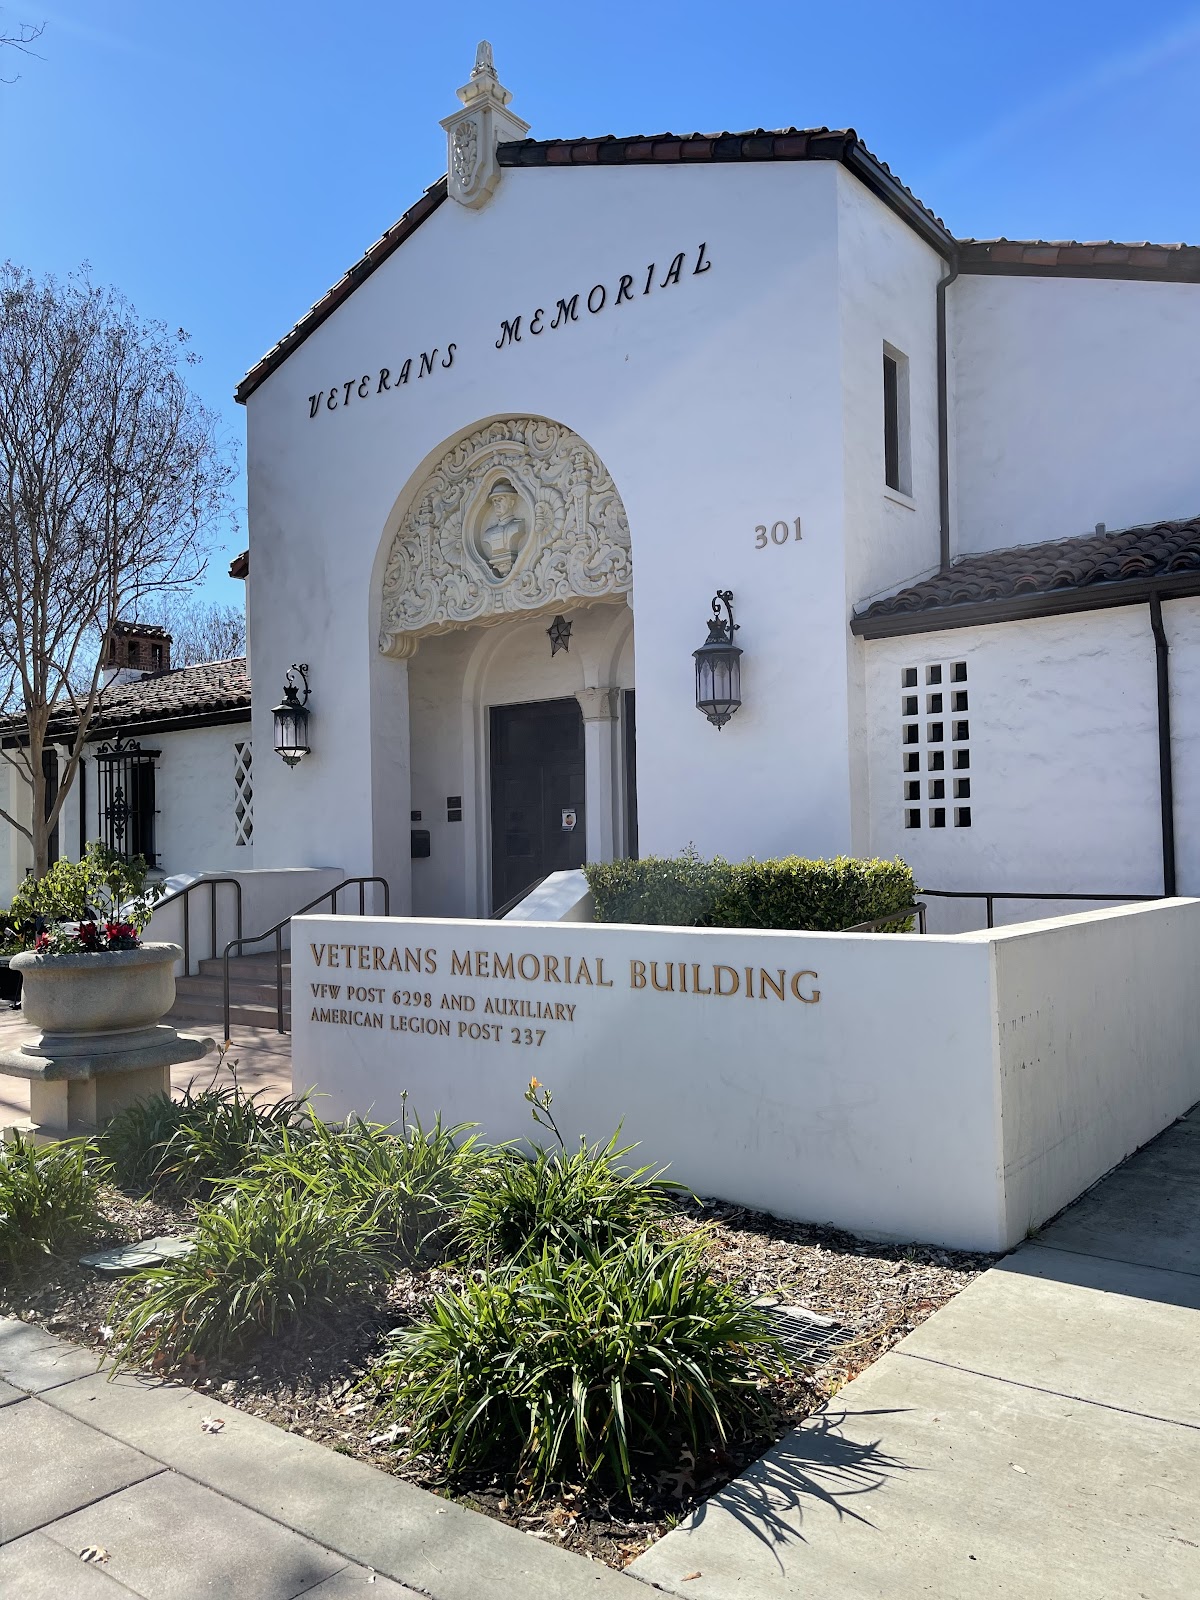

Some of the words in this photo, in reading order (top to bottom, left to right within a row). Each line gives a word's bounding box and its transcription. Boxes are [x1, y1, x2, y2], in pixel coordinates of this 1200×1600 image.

[308, 343, 457, 418] VETERANS
[495, 242, 712, 349] MEMORIAL
[755, 517, 802, 549] 301
[310, 943, 437, 974] VETERANS
[450, 950, 613, 987] MEMORIAL
[630, 960, 821, 1004] BUILDING
[310, 982, 341, 999] VFW
[347, 986, 386, 1003] POST
[392, 990, 432, 1008] 6298
[440, 994, 475, 1012] AND
[484, 997, 576, 1022] AUXILIARY
[310, 1007, 383, 1029] AMERICAN
[390, 1015, 450, 1036] LEGION
[458, 1022, 503, 1042] POST
[511, 1027, 546, 1046] 237
